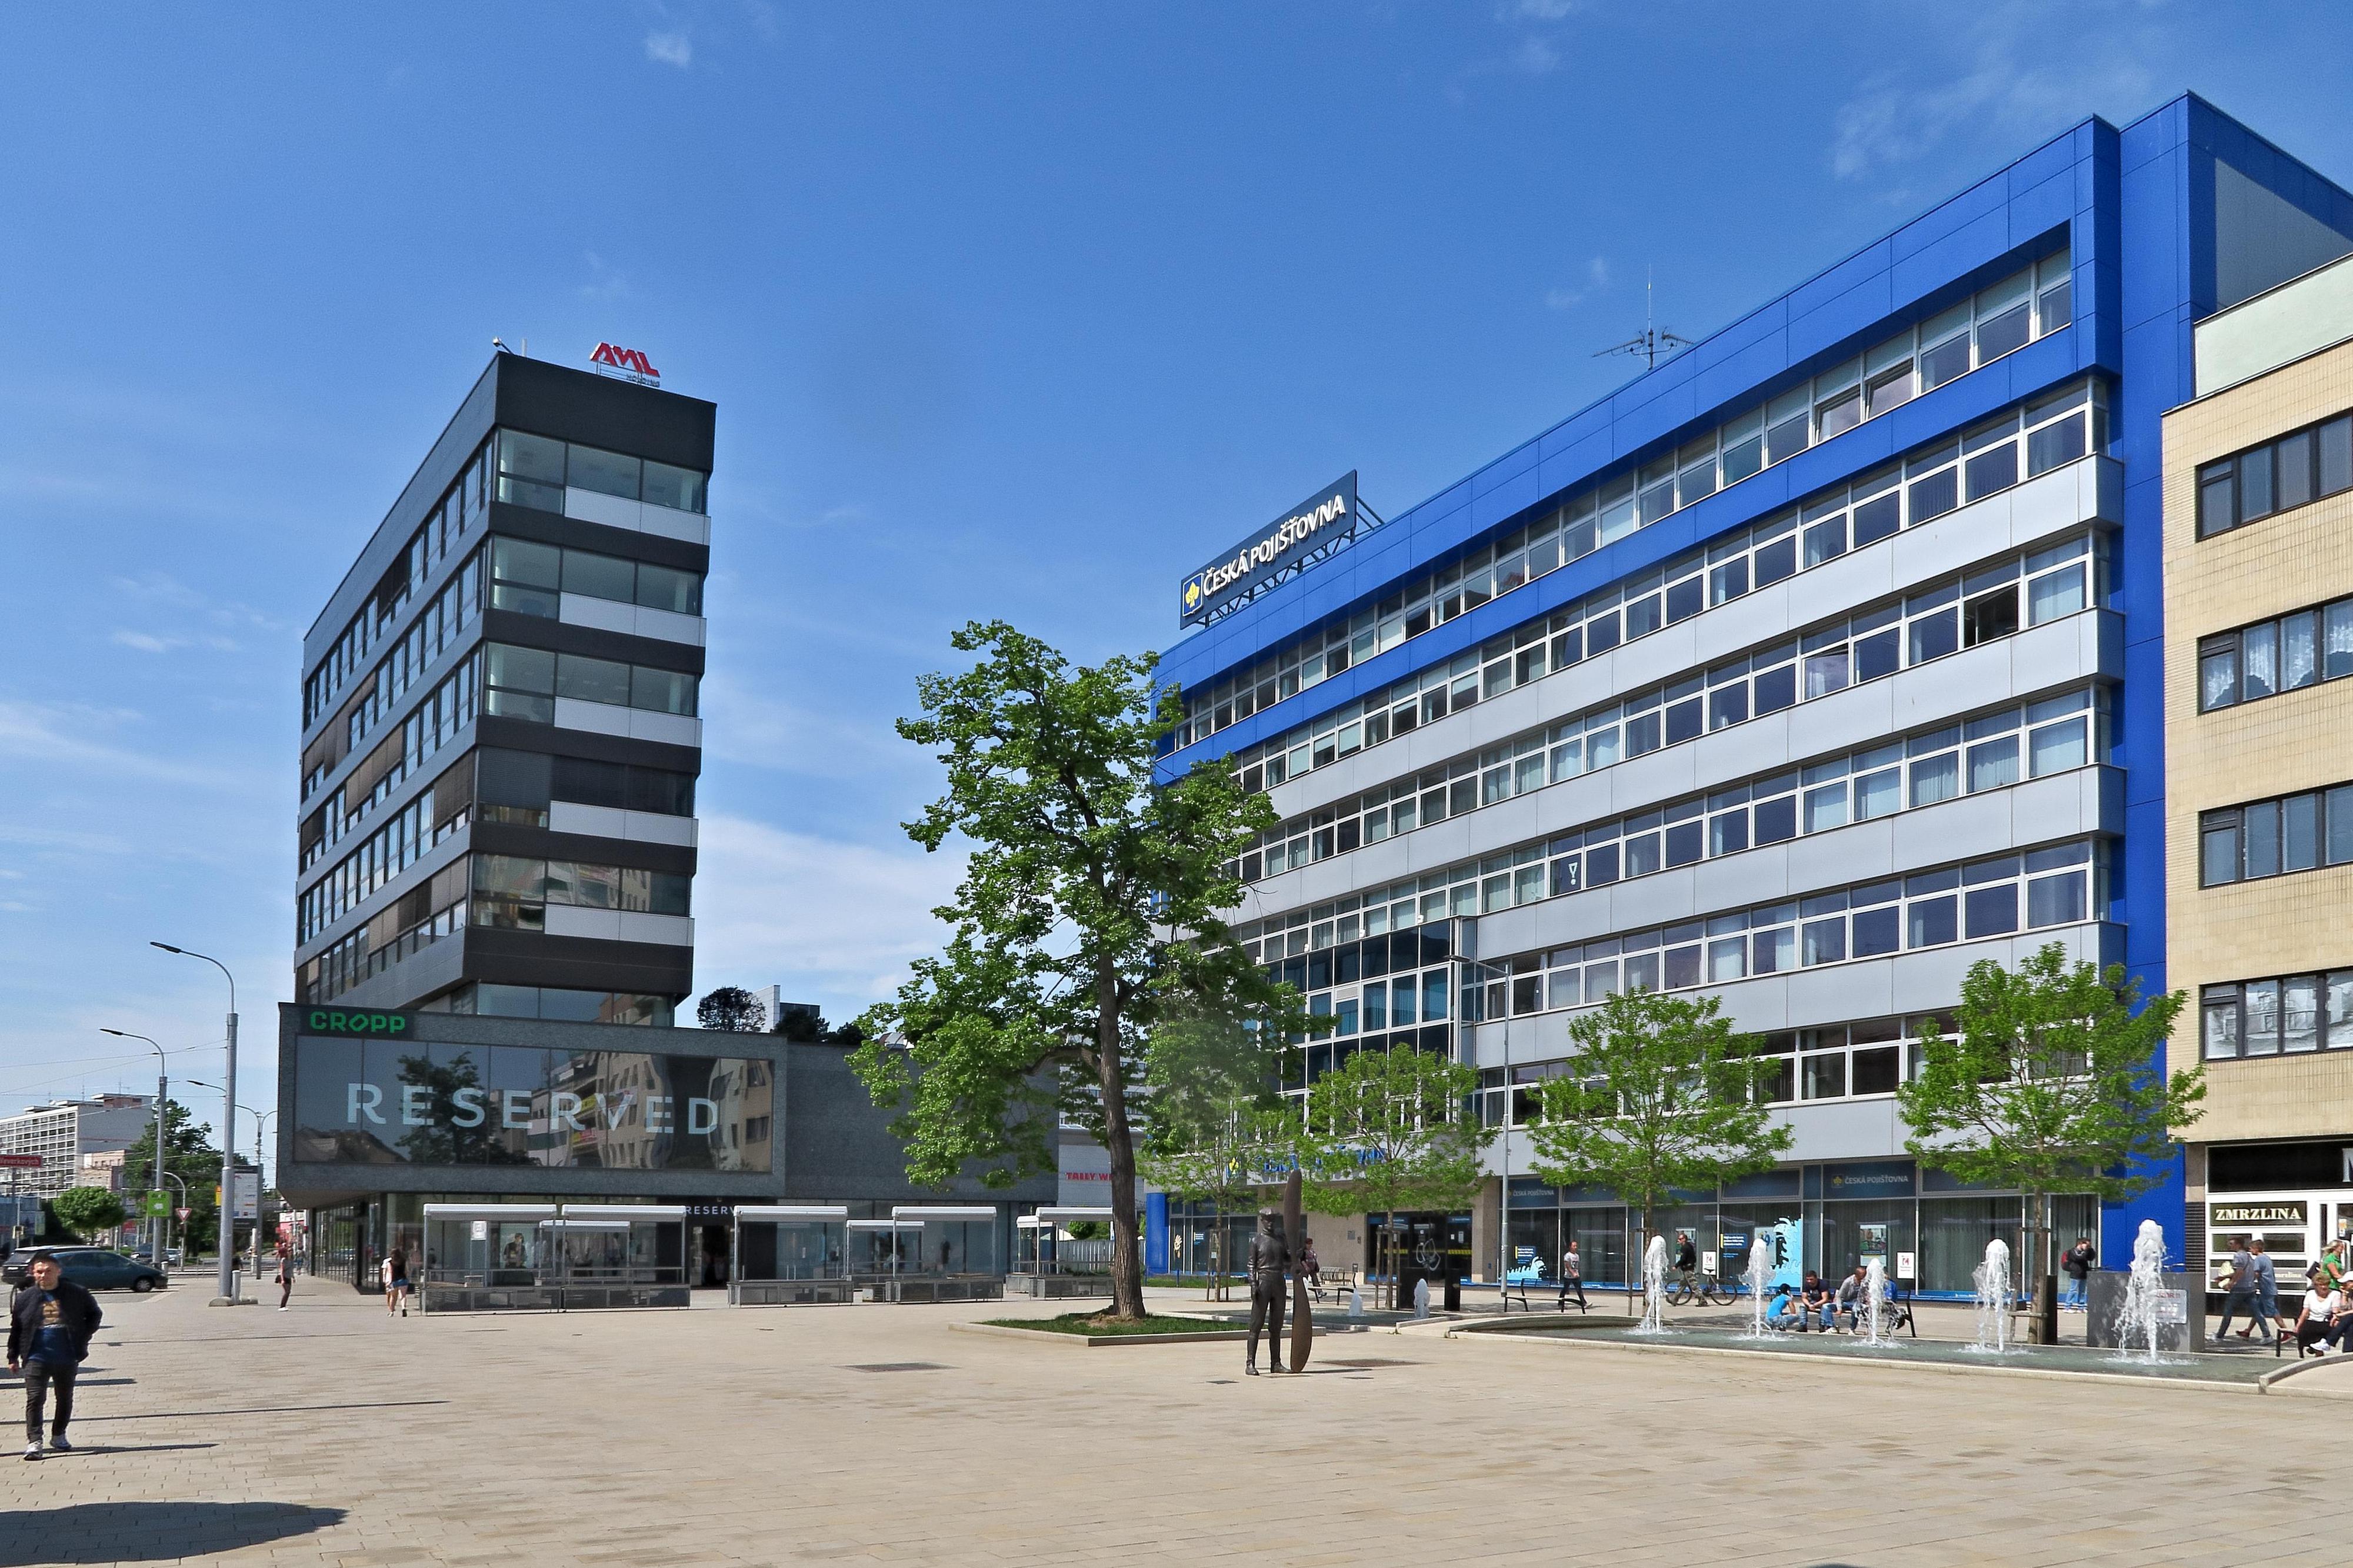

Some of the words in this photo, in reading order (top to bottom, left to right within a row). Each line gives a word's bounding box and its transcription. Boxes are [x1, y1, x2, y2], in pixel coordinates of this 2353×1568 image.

[590, 342, 660, 378] AML
[1203, 549, 1249, 596] ČESKÁ
[1250, 494, 1346, 569] POJIŠŤOVNA
[310, 1011, 406, 1033] CROPP
[347, 1083, 719, 1135] RESERVED
[1845, 1176, 1866, 1184] ČESKÁ
[685, 1206, 735, 1215] RESERV
[2215, 1208, 2301, 1220] ZMRZLINA
